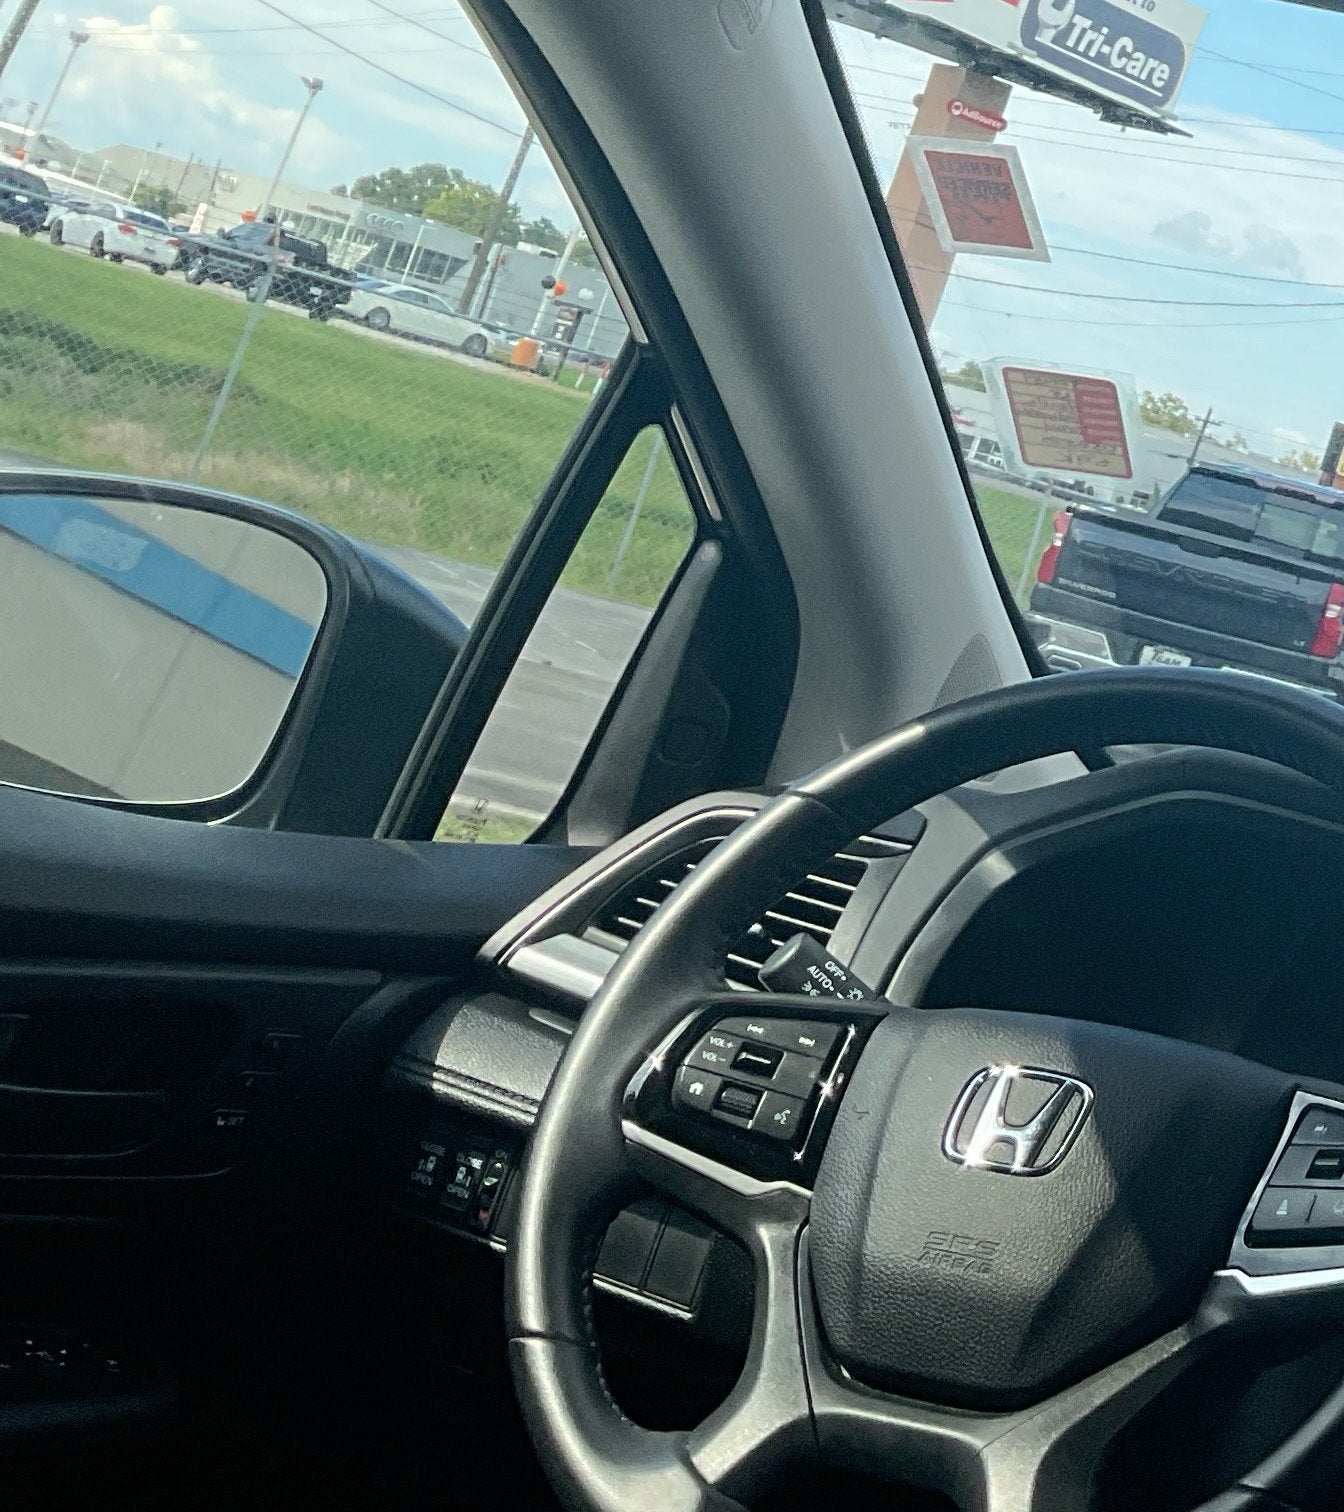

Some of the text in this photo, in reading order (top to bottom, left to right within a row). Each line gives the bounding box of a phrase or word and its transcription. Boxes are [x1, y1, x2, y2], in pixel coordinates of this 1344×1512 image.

[1066, 14, 1170, 88] Tri-Care
[807, 966, 833, 989] AUTO
[825, 961, 845, 977] OFF
